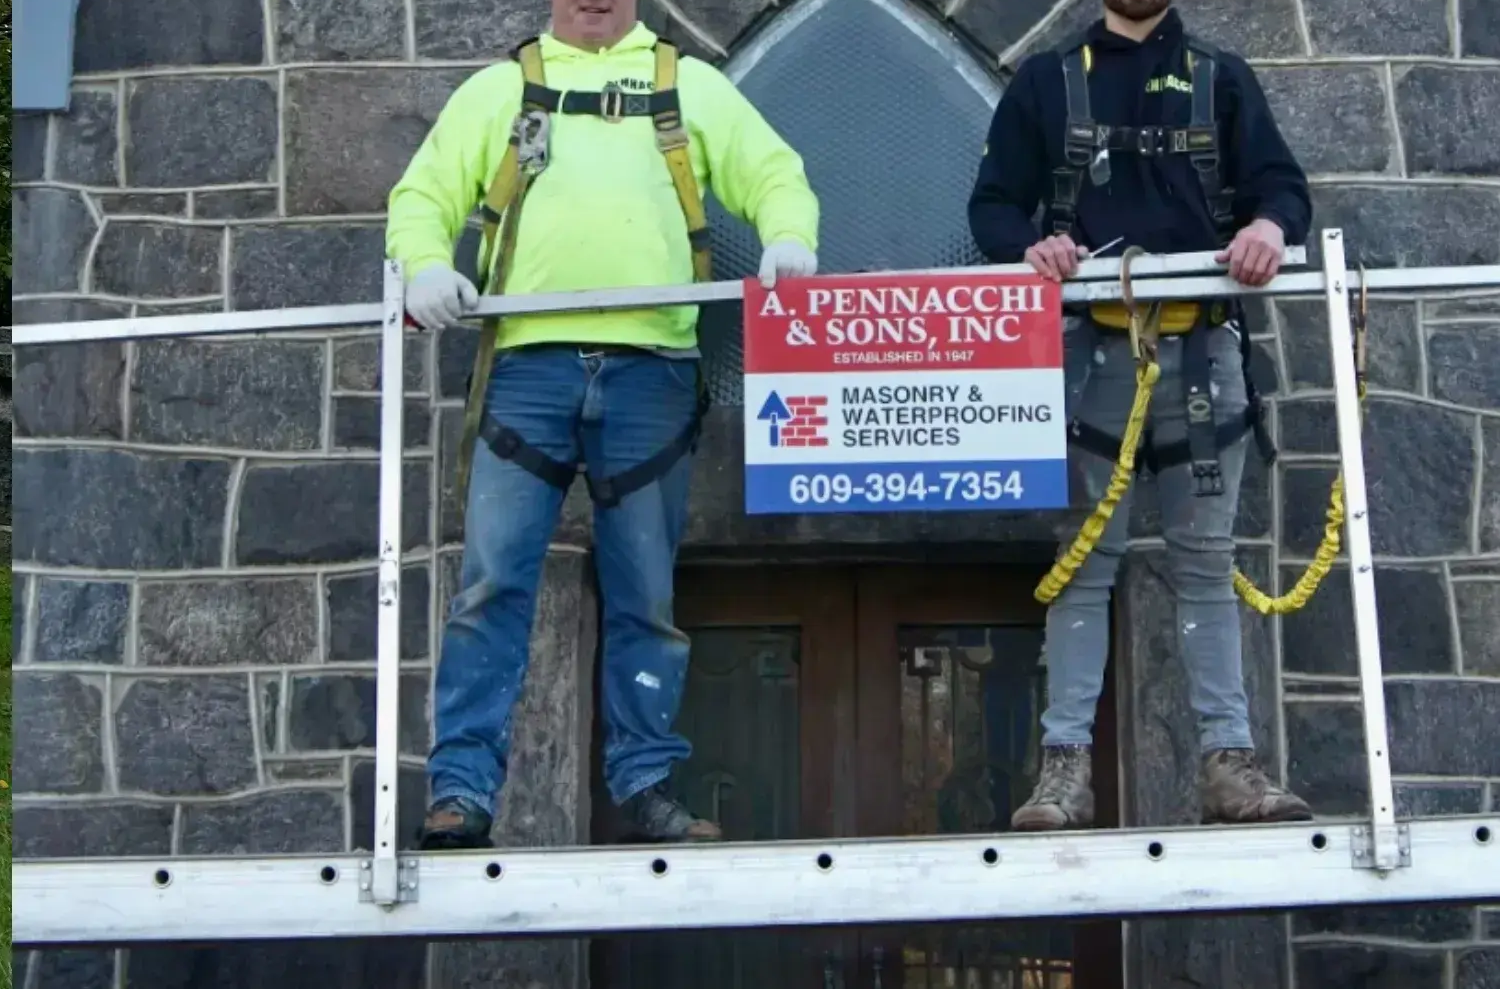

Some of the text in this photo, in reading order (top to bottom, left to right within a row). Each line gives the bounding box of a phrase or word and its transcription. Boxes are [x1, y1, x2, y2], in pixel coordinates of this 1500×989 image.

[759, 285, 1046, 316] A. PENNACCHI
[786, 315, 1022, 350] & SONS, INC
[833, 350, 975, 364] ESTABLISHED IN 1947
[842, 384, 983, 404] MASONRY &
[842, 404, 1052, 425] WATERPROOFING
[843, 427, 960, 447] SERVICES
[789, 471, 1024, 504] 609-394-7354
